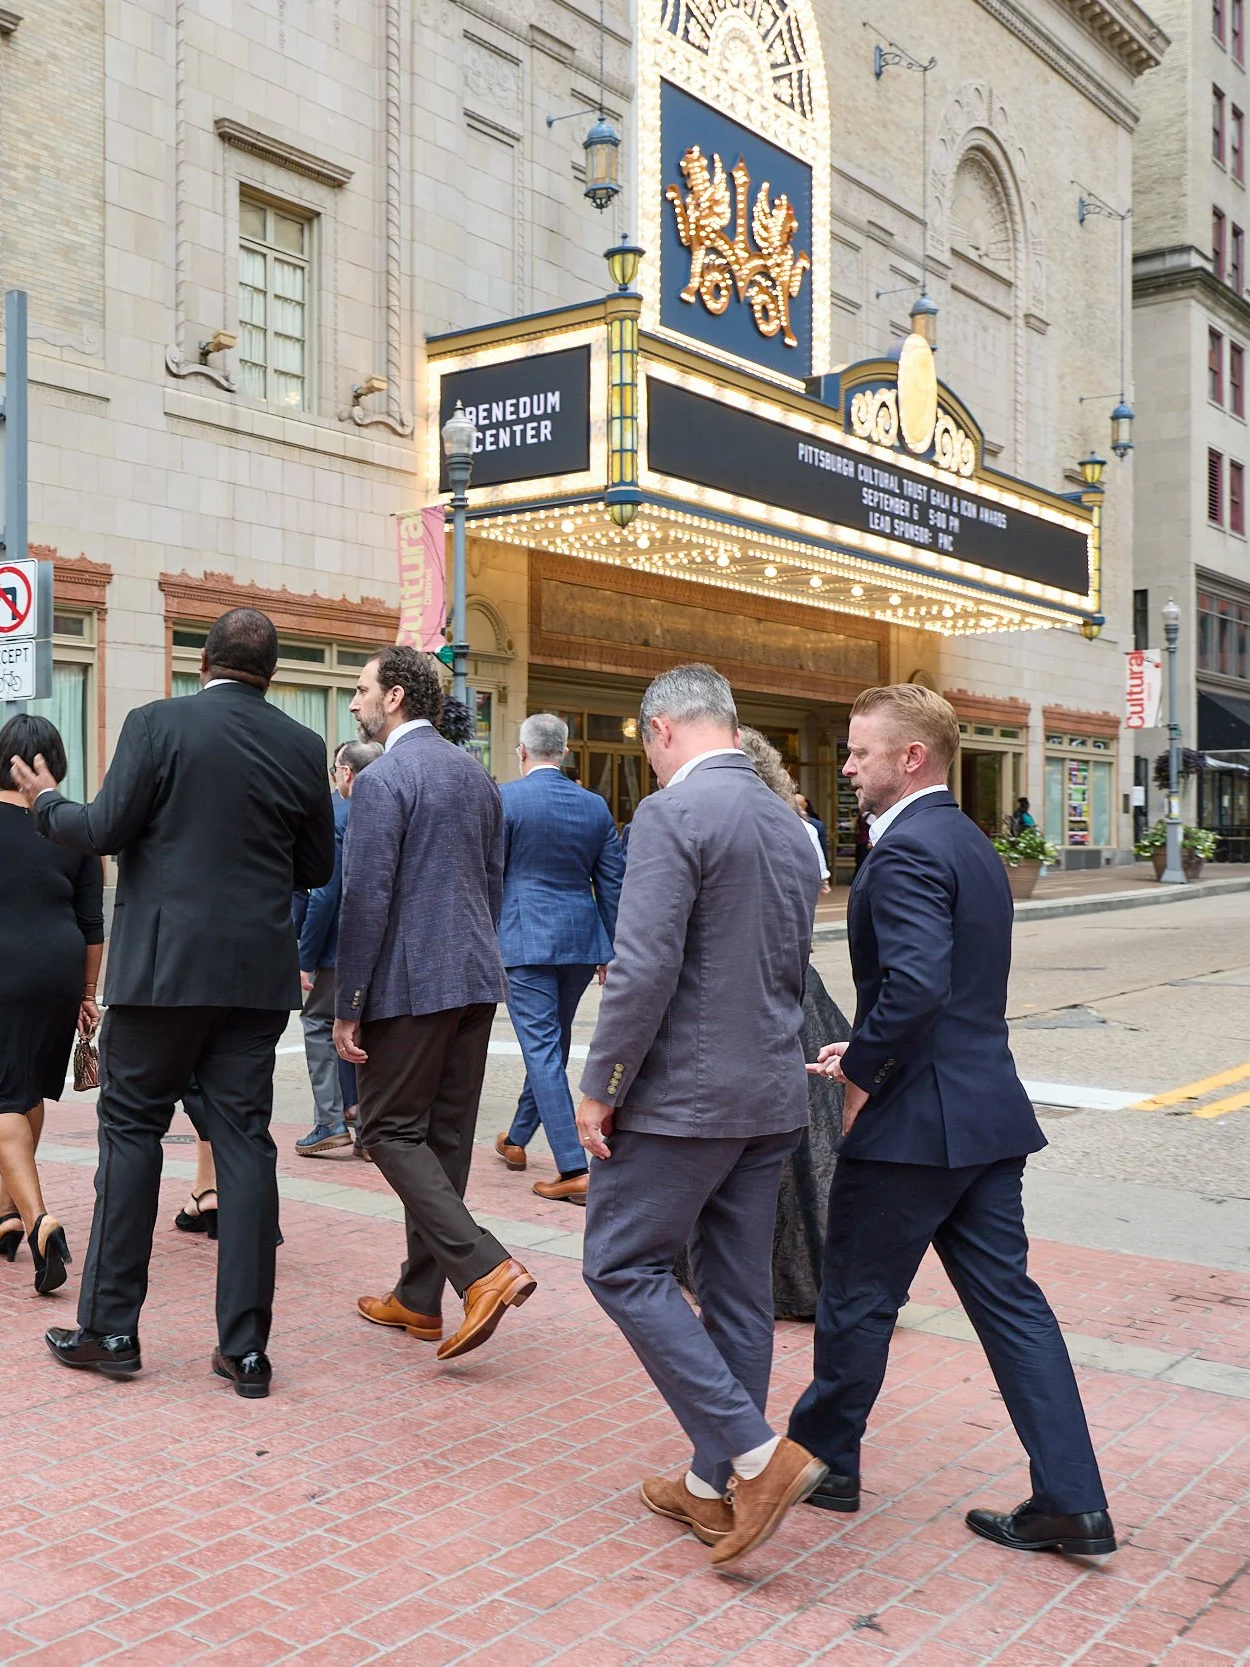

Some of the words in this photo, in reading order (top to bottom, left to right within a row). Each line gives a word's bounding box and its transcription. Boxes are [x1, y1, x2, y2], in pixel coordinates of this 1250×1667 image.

[465, 390, 561, 426] BENEDUM
[472, 420, 552, 453] CENTER
[798, 442, 855, 478] PITTSBURGH
[857, 463, 900, 494] CULTURAL
[902, 478, 928, 502] TRUST
[930, 488, 950, 509] GALA
[952, 496, 958, 513] &
[960, 499, 977, 519] ICON
[979, 506, 1007, 529] AWARDS
[861, 487, 910, 518] SEPTEMBER
[912, 503, 919, 520] 6
[928, 508, 947, 529] 5:00
[948, 515, 960, 534] PM
[869, 511, 891, 533] LEAD
[893, 518, 933, 545] SPONSOR:
[938, 532, 953, 552] PNC
[1126, 650, 1145, 729] Cultural
